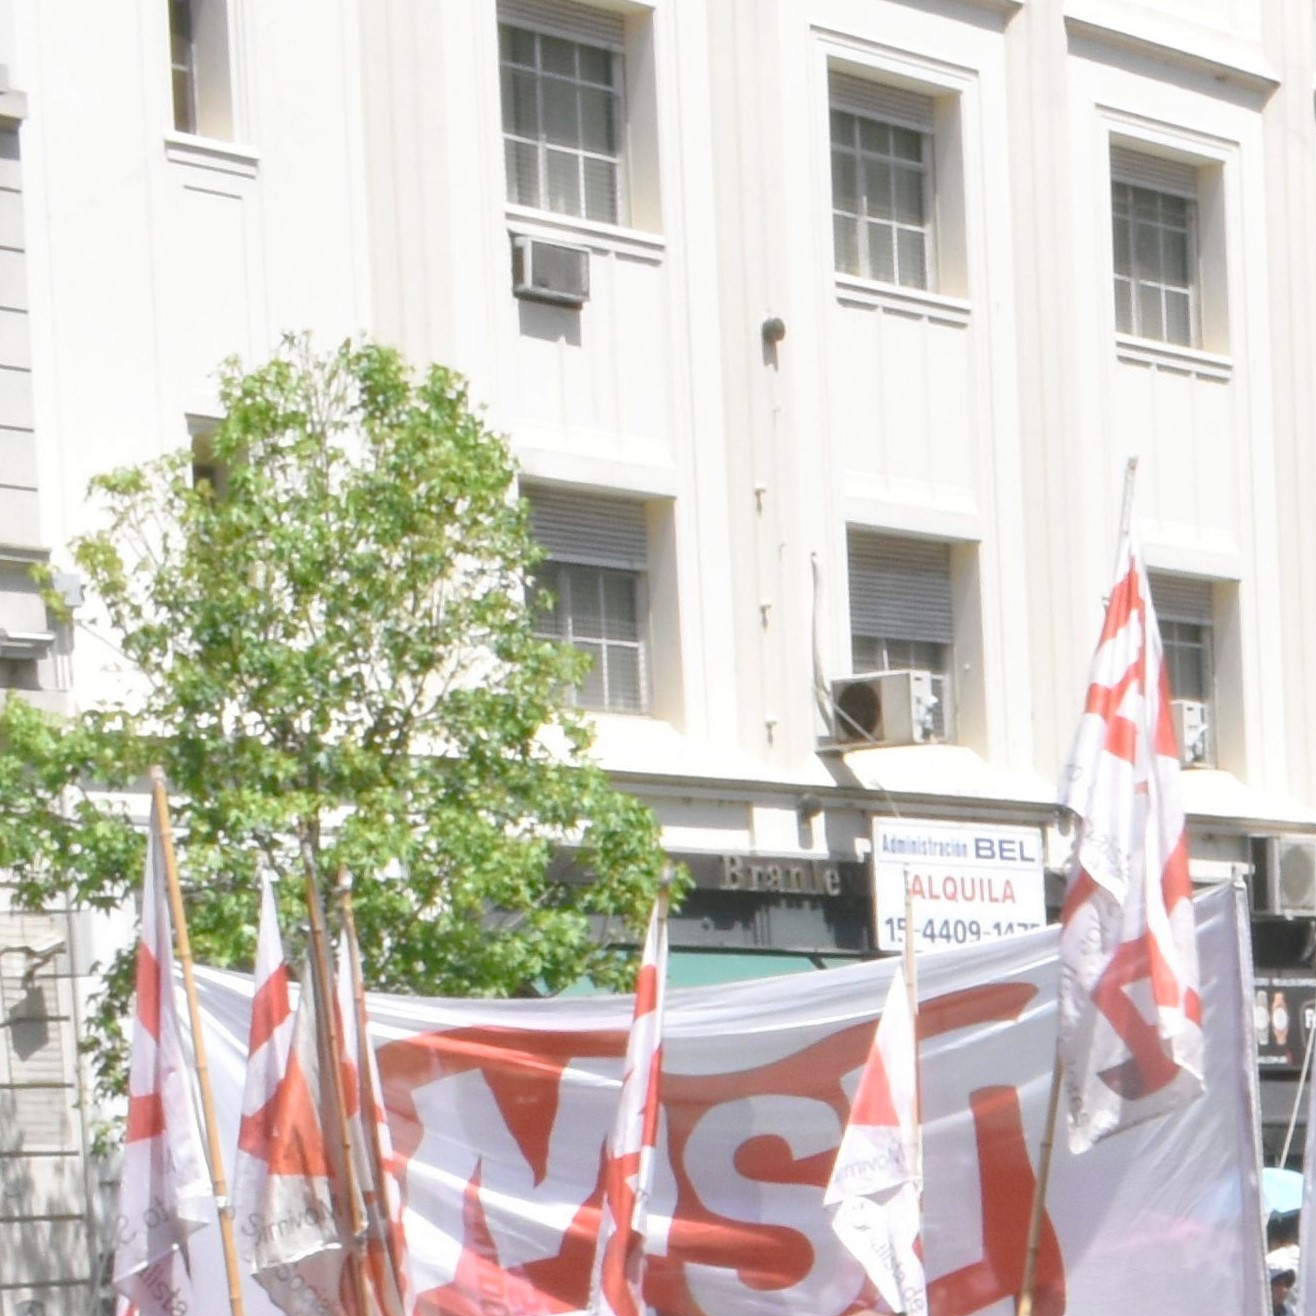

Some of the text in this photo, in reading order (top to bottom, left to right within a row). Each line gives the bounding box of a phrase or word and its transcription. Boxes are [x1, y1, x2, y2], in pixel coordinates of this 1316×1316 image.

[882, 833, 1036, 863] Administración BEL
[910, 874, 1016, 904] ALQUILA
[884, 917, 1041, 944] 15-4409-14
